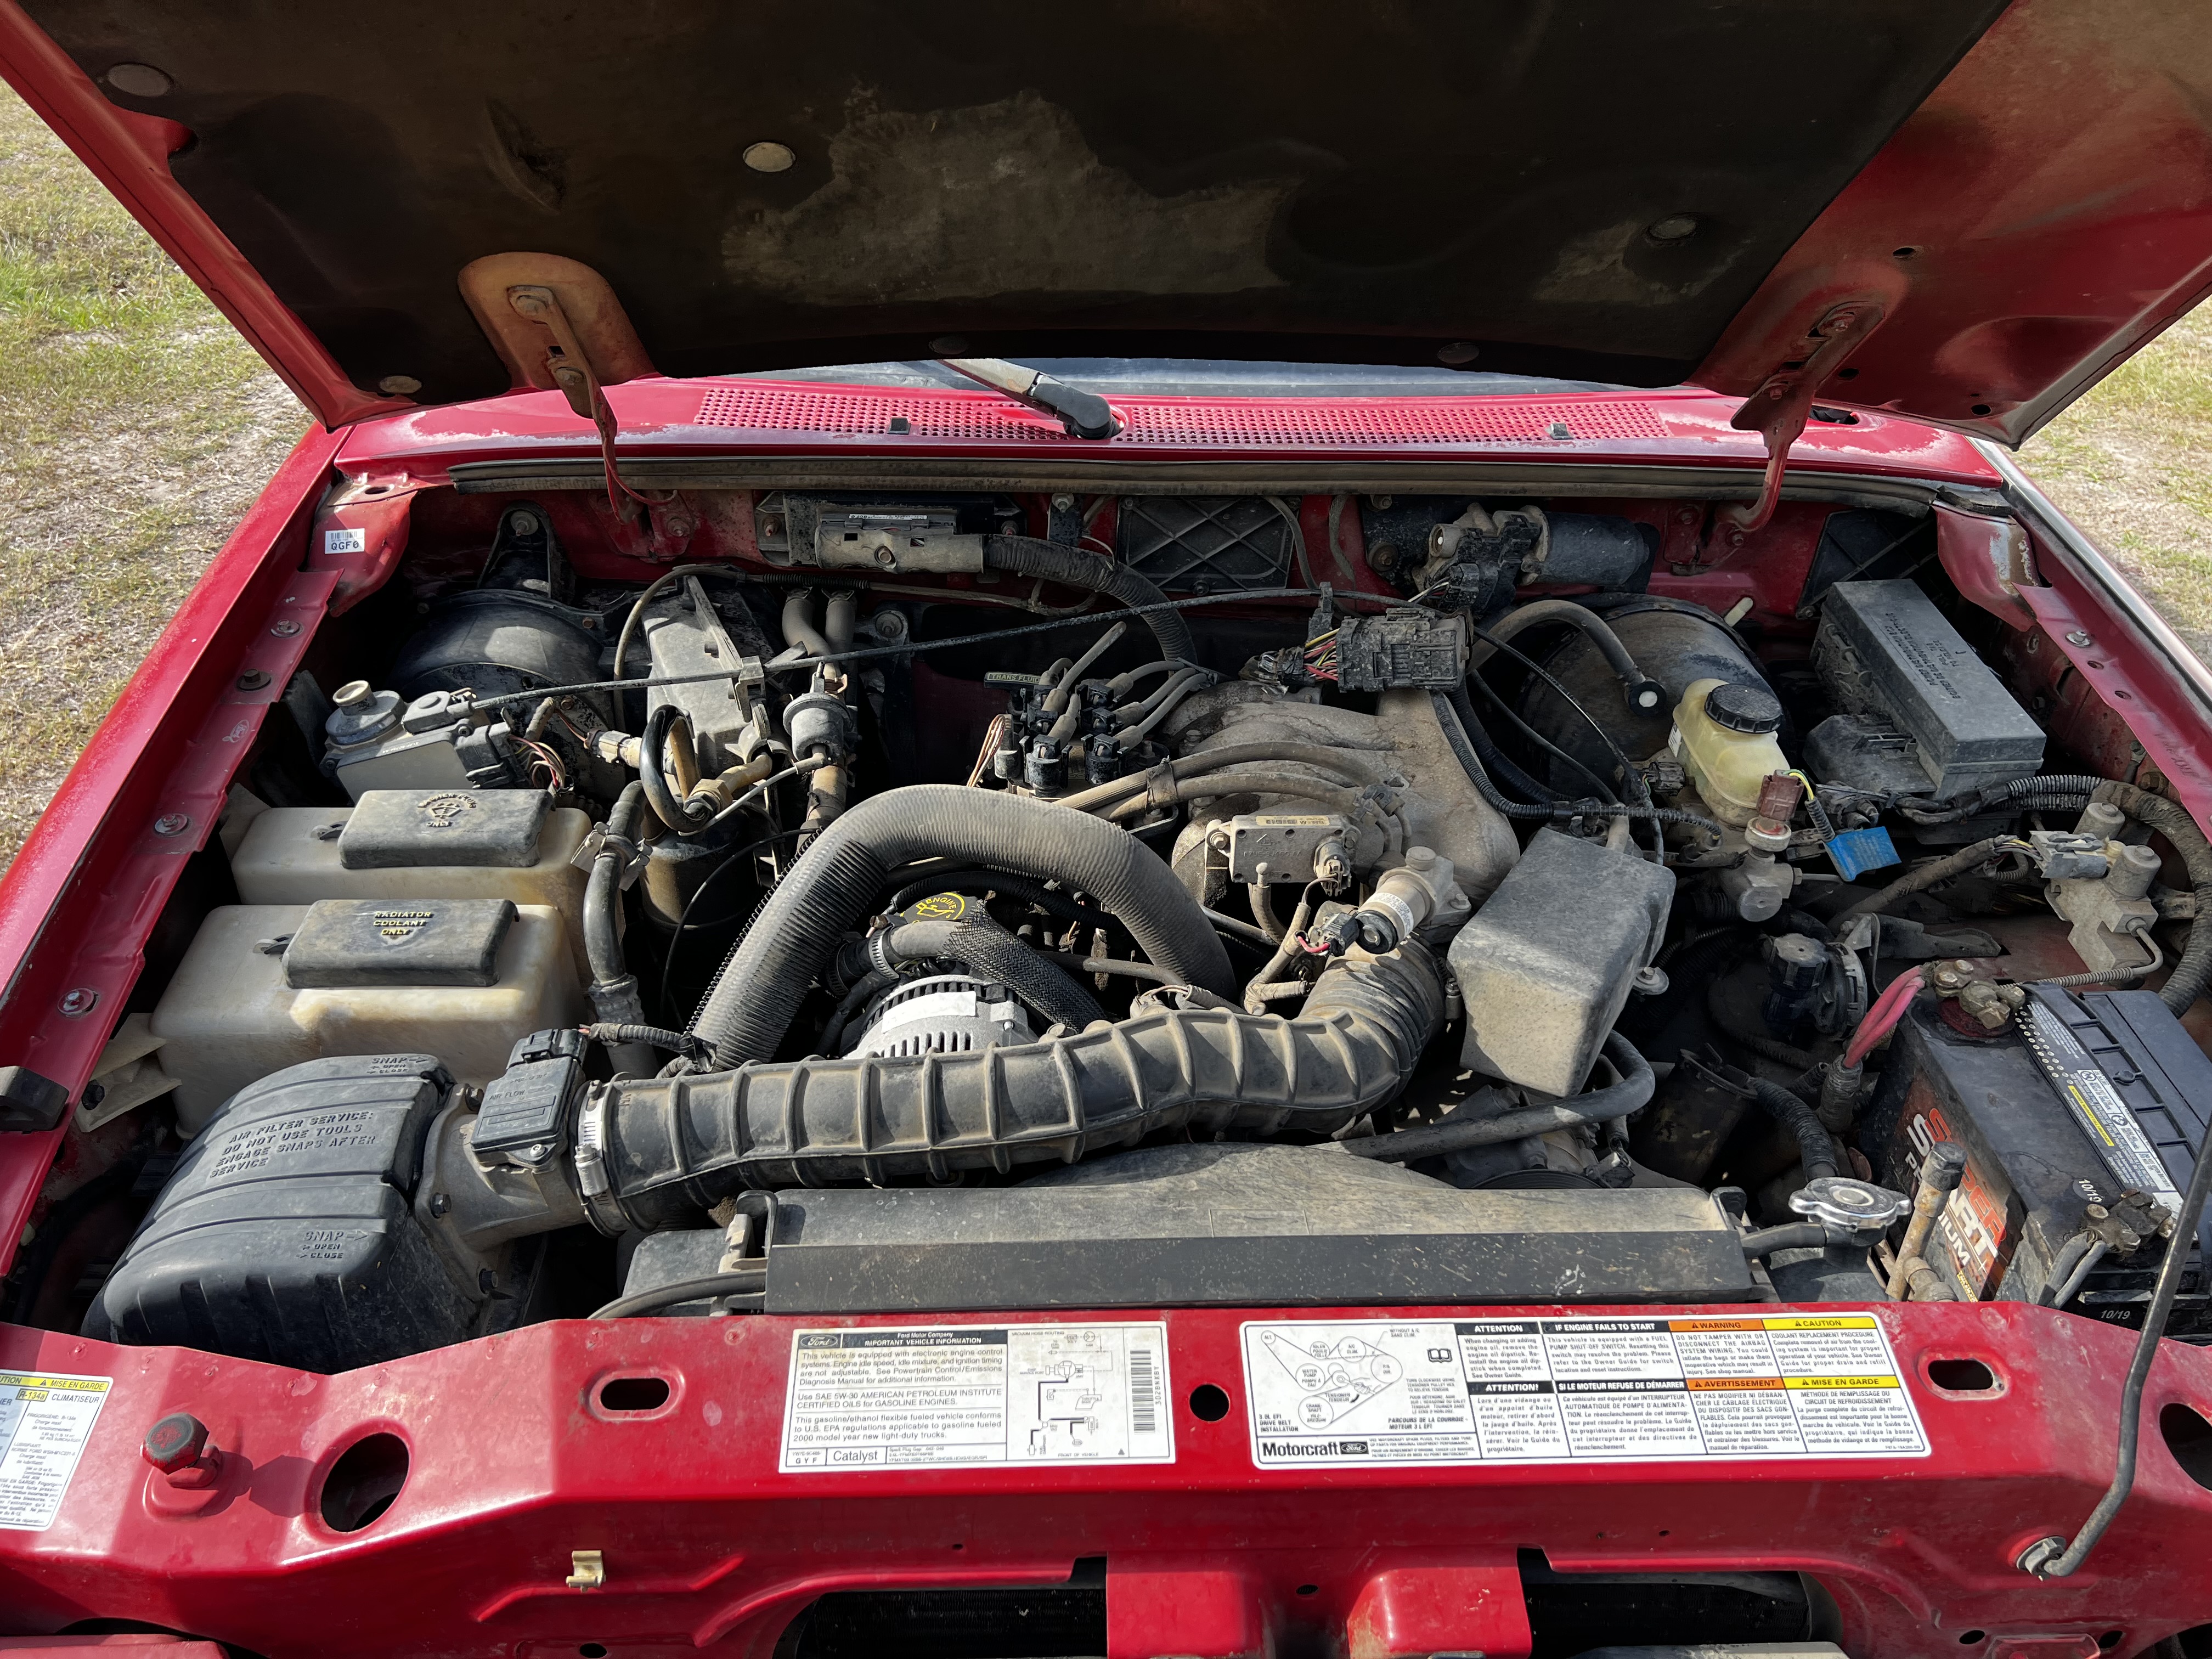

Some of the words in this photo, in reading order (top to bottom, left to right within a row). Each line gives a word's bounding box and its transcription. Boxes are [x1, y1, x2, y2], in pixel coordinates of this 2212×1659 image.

[925, 897, 957, 910] ENGINE
[505, 1090, 526, 1098] FLOW
[228, 1131, 251, 1144] AIR
[256, 1119, 304, 1136] FILTER
[309, 1111, 374, 1126] SERVICE:
[221, 1142, 241, 1156] DO
[245, 1135, 276, 1149] NOT
[281, 1129, 309, 1141] USE
[316, 1124, 363, 1136] TOOLS
[216, 1146, 271, 1167] ENGAGE
[276, 1139, 323, 1153] SNAPS
[328, 1135, 376, 1147] AFTER
[209, 1156, 269, 1178] SERVICE
[2078, 1179, 2102, 1203] 10/19
[303, 1231, 344, 1240] SNAP
[2100, 1310, 2131, 1319] 10/19
[935, 1338, 982, 1346] INFORMATION
[833, 1360, 857, 1368] Engine
[912, 1358, 939, 1367] mixture,
[955, 1357, 980, 1367] ignition
[831, 1368, 871, 1376] adjustable.
[799, 1378, 836, 1386] Diagnosis
[1576, 1382, 1607, 1390] MOTEUR
[1645, 1381, 1685, 1389] DÉMARRER
[19, 1391, 46, 1400] R-134a
[52, 1393, 100, 1403] CLIMATISEUR
[814, 1415, 878, 1424] gasoline/ethanol
[804, 1424, 821, 1432] U.S.
[842, 1424, 886, 1432] regulations
[889, 1423, 929, 1431] applicable
[881, 1431, 918, 1440] light-duty
[1262, 1442, 1339, 1456] Motorcraft
[833, 1449, 877, 1462] Catalyst
